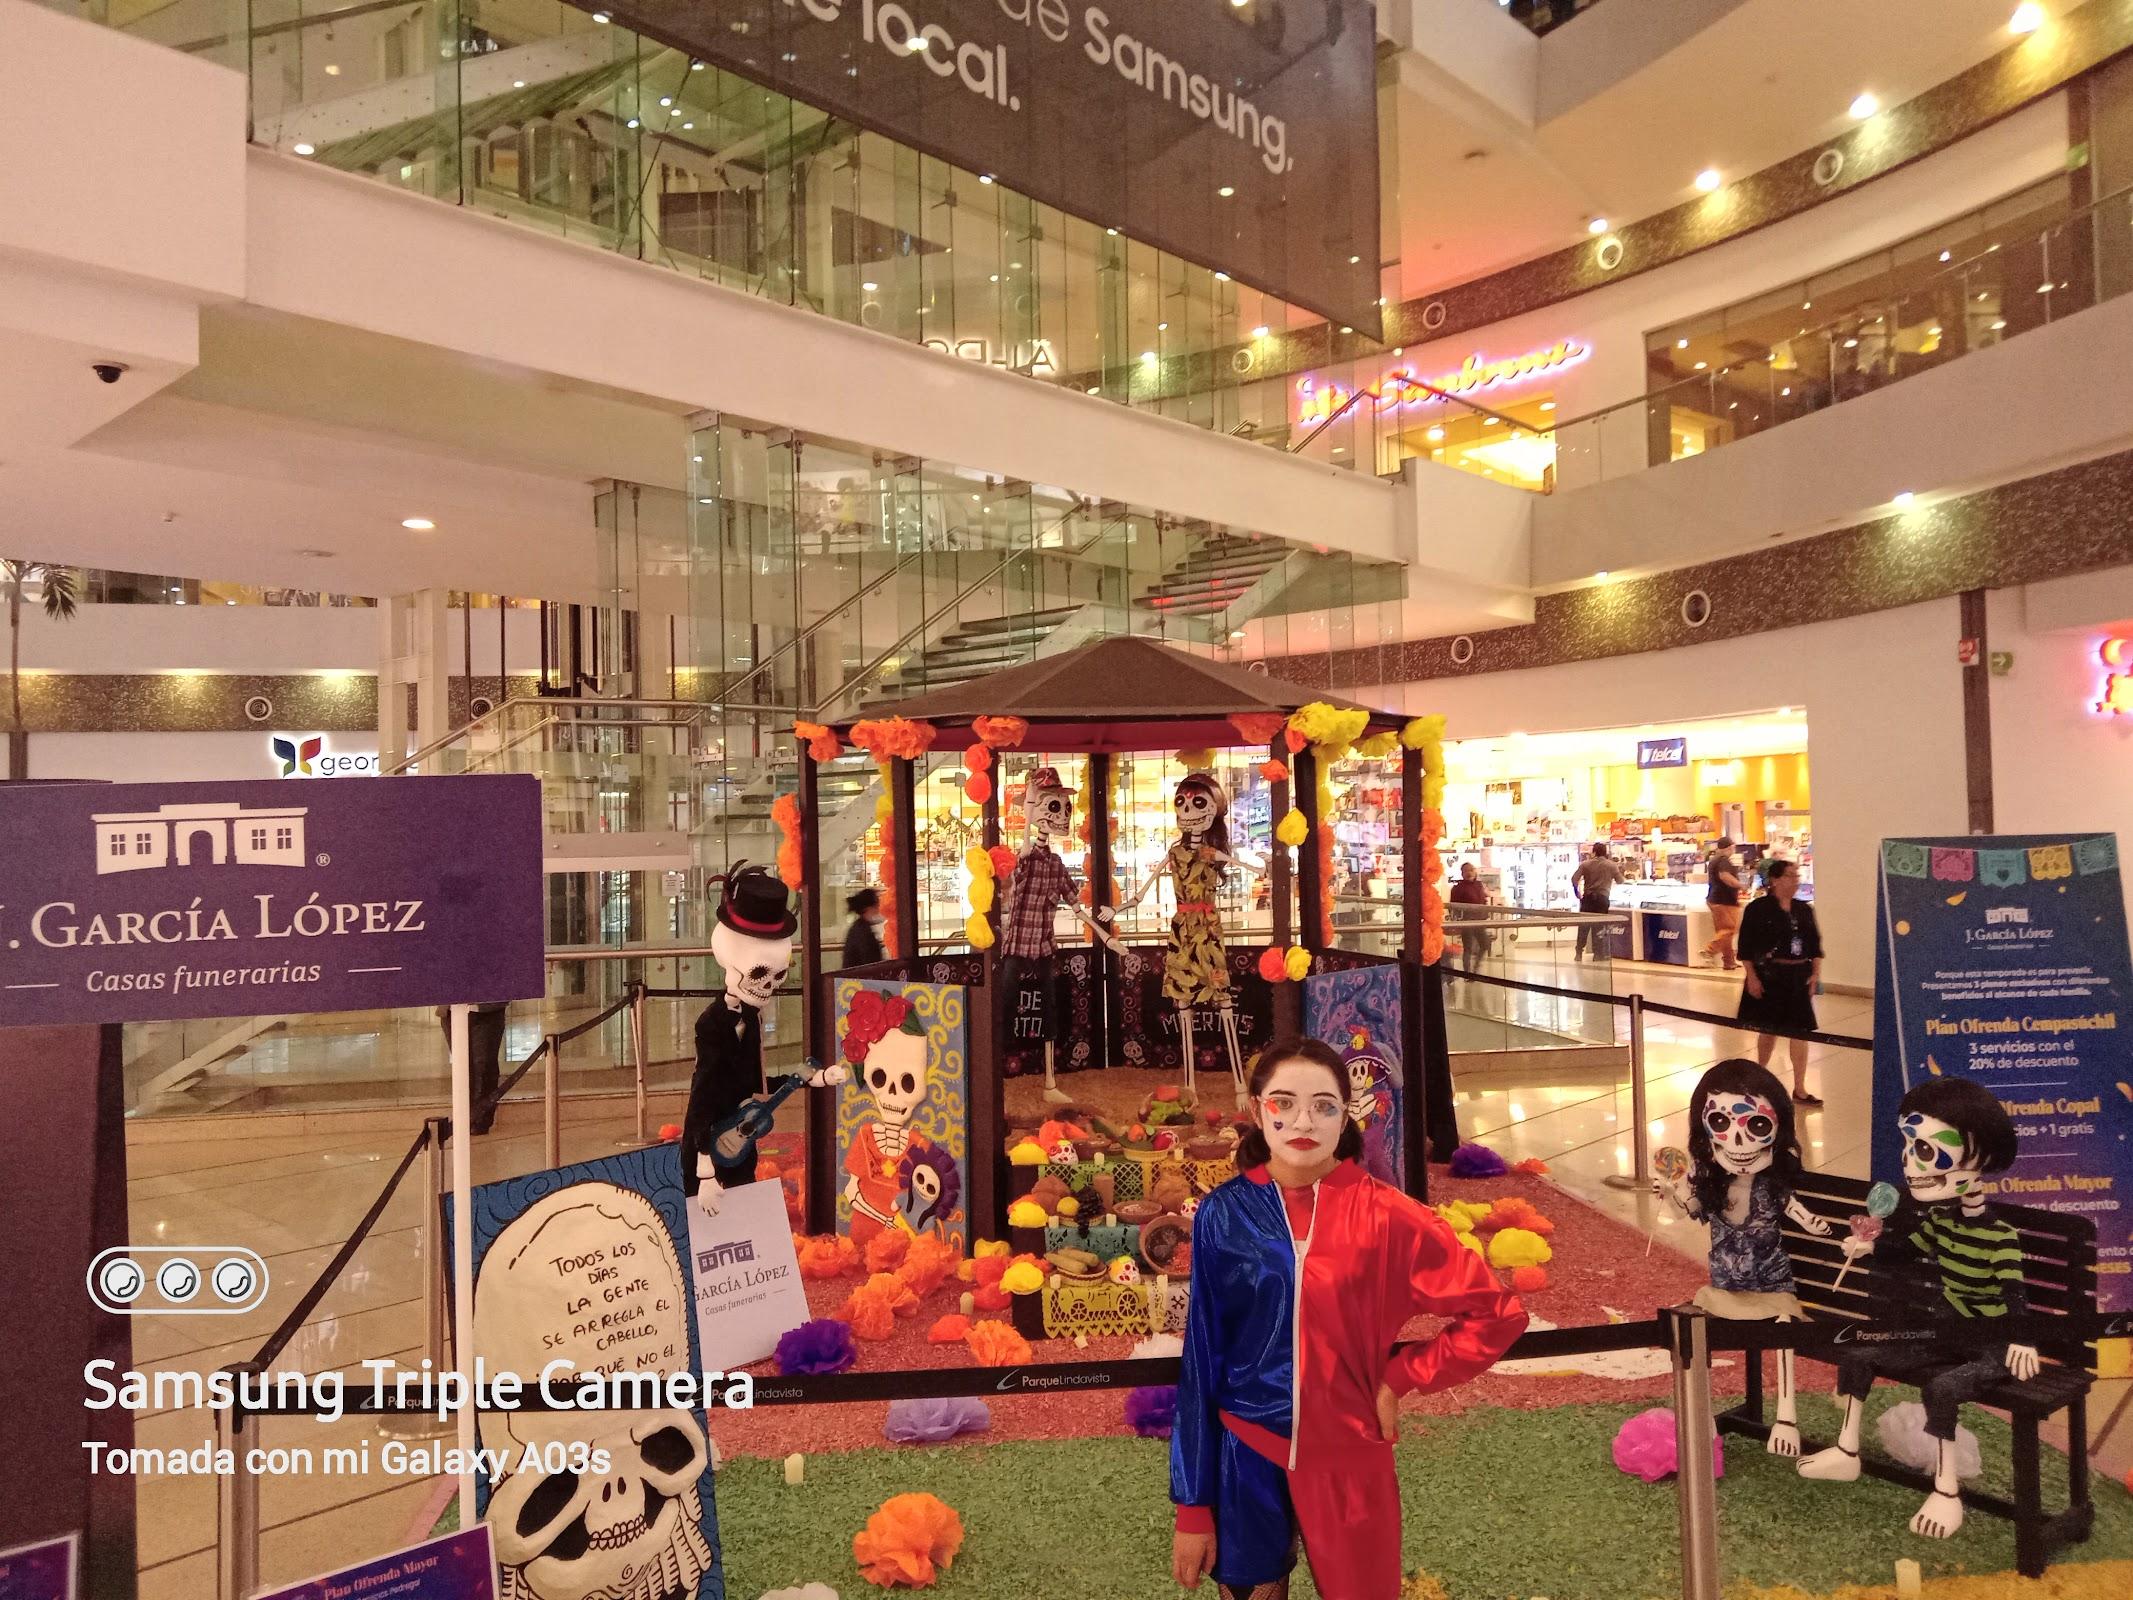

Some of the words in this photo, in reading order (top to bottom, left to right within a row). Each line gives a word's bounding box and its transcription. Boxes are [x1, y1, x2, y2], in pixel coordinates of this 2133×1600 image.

[862, 0, 1021, 112] local.
[31, 897, 238, 948] GARCÍA
[253, 892, 427, 939] LÓPEZ
[86, 970, 166, 993] Casas
[173, 960, 321, 995] funerarias
[1926, 1020, 1958, 1035] Plan
[1960, 1017, 2020, 1034] Ofrenda
[1969, 1043, 1978, 1054] 3
[1980, 1040, 2037, 1054] servicios
[2038, 1042, 2060, 1052] con
[2063, 1039, 2075, 1051] el
[1969, 1057, 1995, 1070] 20%
[1996, 1057, 2013, 1068] de
[2015, 1055, 2080, 1067] descuento
[2056, 1096, 2101, 1117] Copal
[2058, 1122, 2095, 1137] gratis
[2001, 1175, 2062, 1193] Ofrenda
[2050, 1199, 2120, 1212] descuento
[549, 1249, 605, 1277] TODOS
[612, 1242, 636, 1258] LOS
[588, 1266, 619, 1285] DÍAS
[745, 1265, 790, 1288] LÓPEZ
[567, 1297, 592, 1315] LA
[603, 1278, 649, 1303] GENTE
[705, 1303, 727, 1316] Casas
[727, 1292, 767, 1311] funerarias
[542, 1332, 565, 1350] SE
[573, 1305, 645, 1337] ARREGLA
[655, 1299, 670, 1311] EL
[596, 1324, 658, 1351] CABELLO,
[636, 1352, 658, 1369] NO
[663, 1344, 676, 1358] EL
[1022, 1373, 1110, 1388] ParqueLindavista
